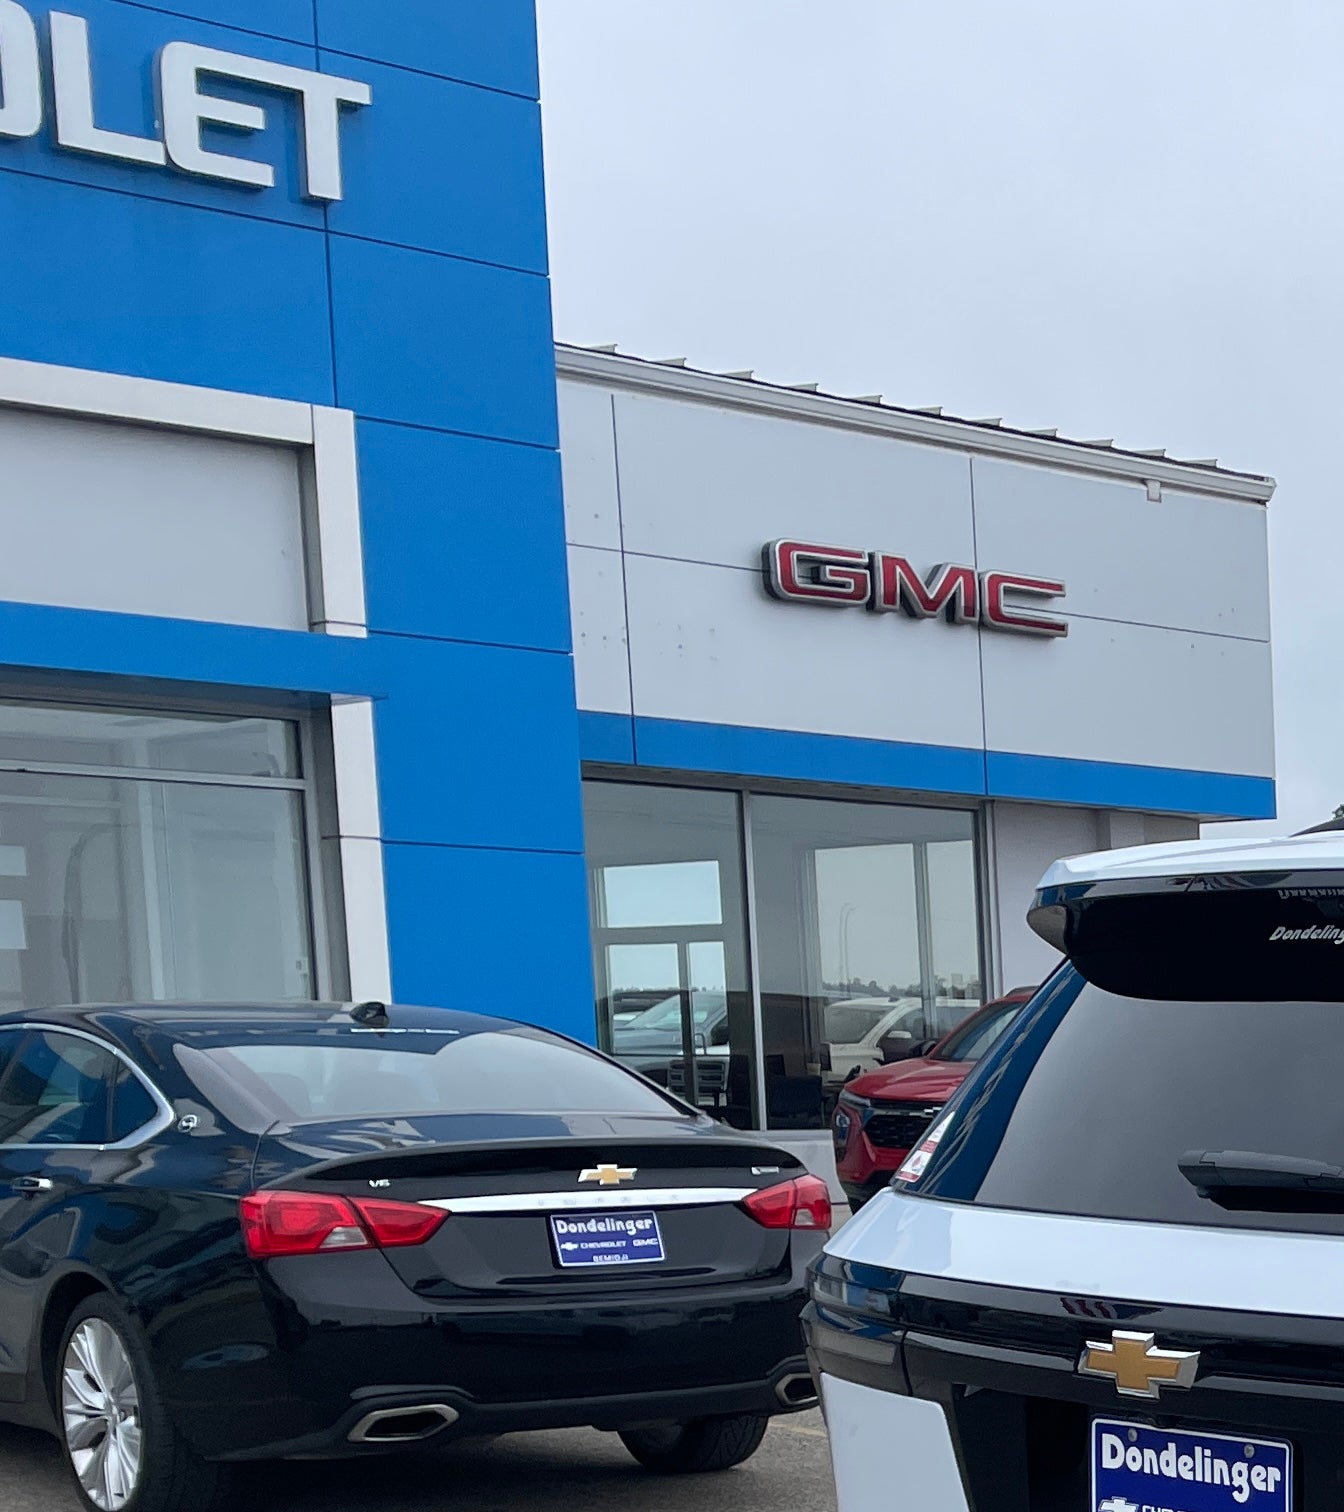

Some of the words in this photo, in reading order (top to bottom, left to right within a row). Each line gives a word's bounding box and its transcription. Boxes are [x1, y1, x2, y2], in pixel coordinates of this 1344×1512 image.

[762, 537, 1067, 638] GMC
[555, 1218, 653, 1236] Dondelinger
[632, 1237, 659, 1247] GMC
[1101, 1432, 1281, 1504] Dondelinger
